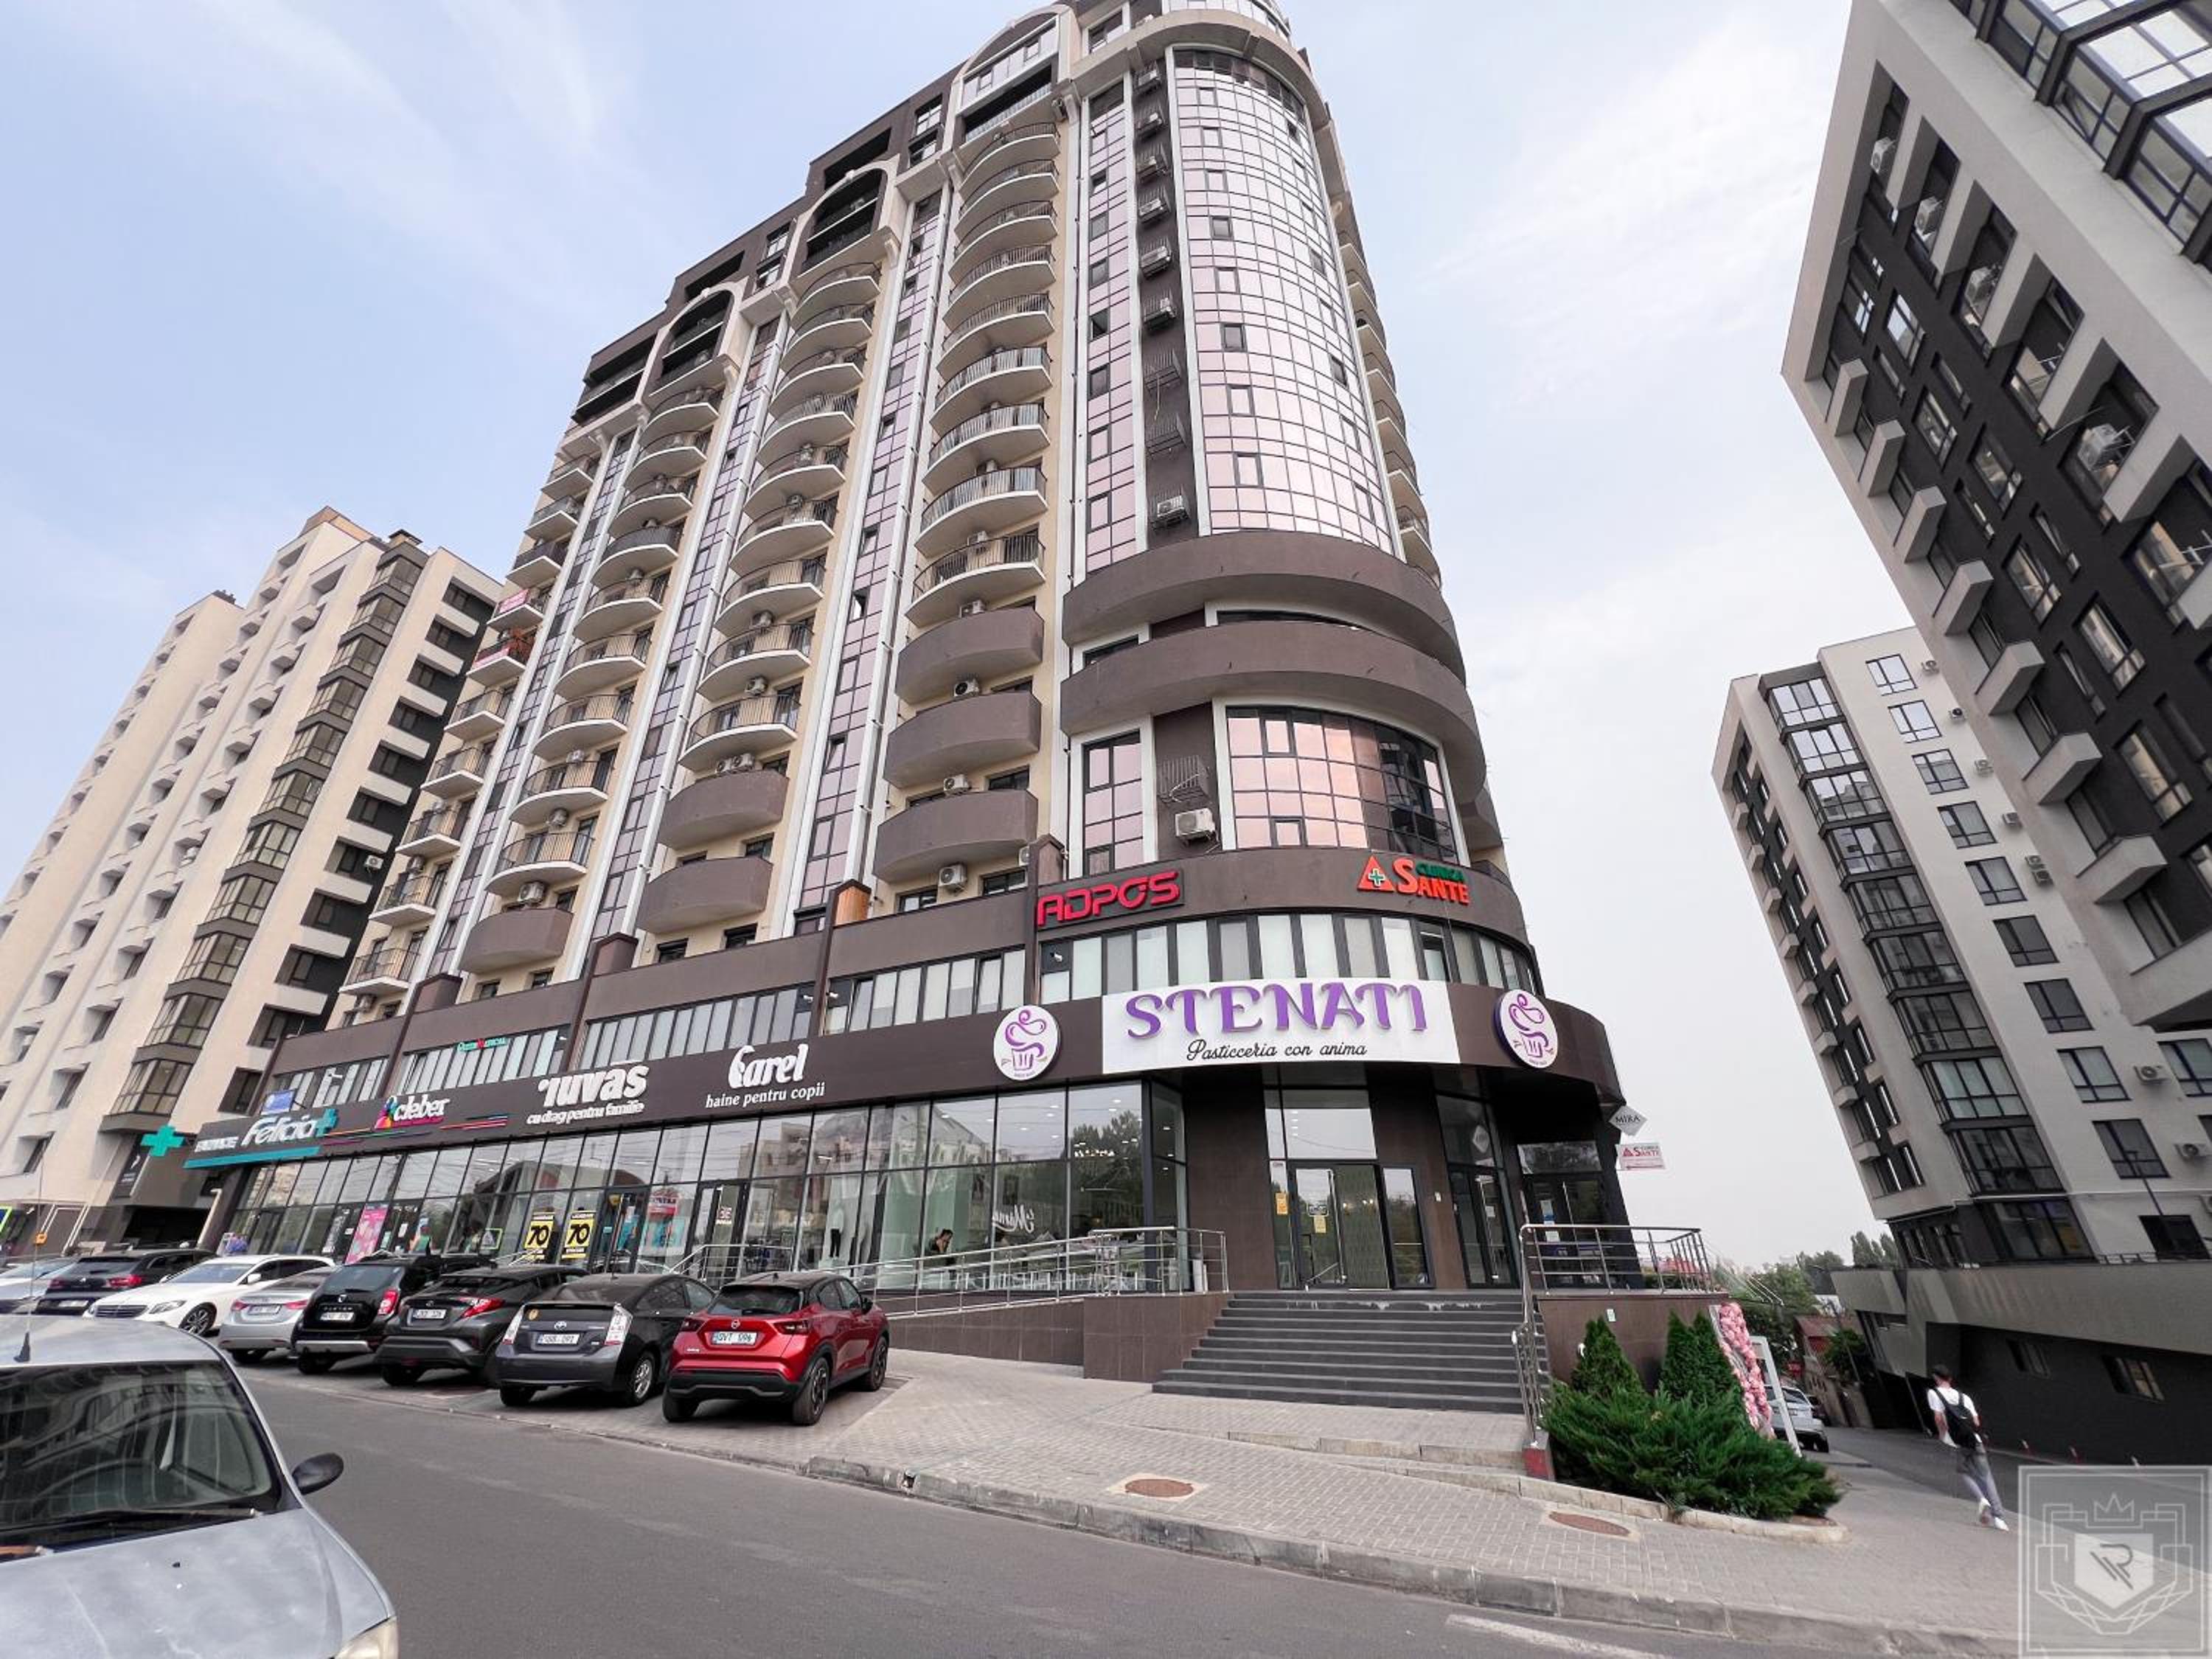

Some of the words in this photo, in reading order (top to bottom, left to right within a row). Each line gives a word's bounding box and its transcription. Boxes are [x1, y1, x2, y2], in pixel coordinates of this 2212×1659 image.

[1392, 858, 1470, 906] SANTE
[1037, 869, 1180, 928] ADPOS
[1125, 982, 1427, 1039] STENATI
[1186, 1039, 1278, 1061] Pasticceria
[1284, 1045, 1312, 1056] con
[1320, 1042, 1368, 1056] anima
[728, 1043, 809, 1088] Carel
[706, 1094, 740, 1108] haine
[742, 1089, 787, 1107] pentru
[790, 1082, 825, 1100] copii
[540, 1110, 568, 1124] drag
[566, 1107, 605, 1124] pentru
[528, 1225, 549, 1245] 70
[567, 1224, 590, 1245] 70
